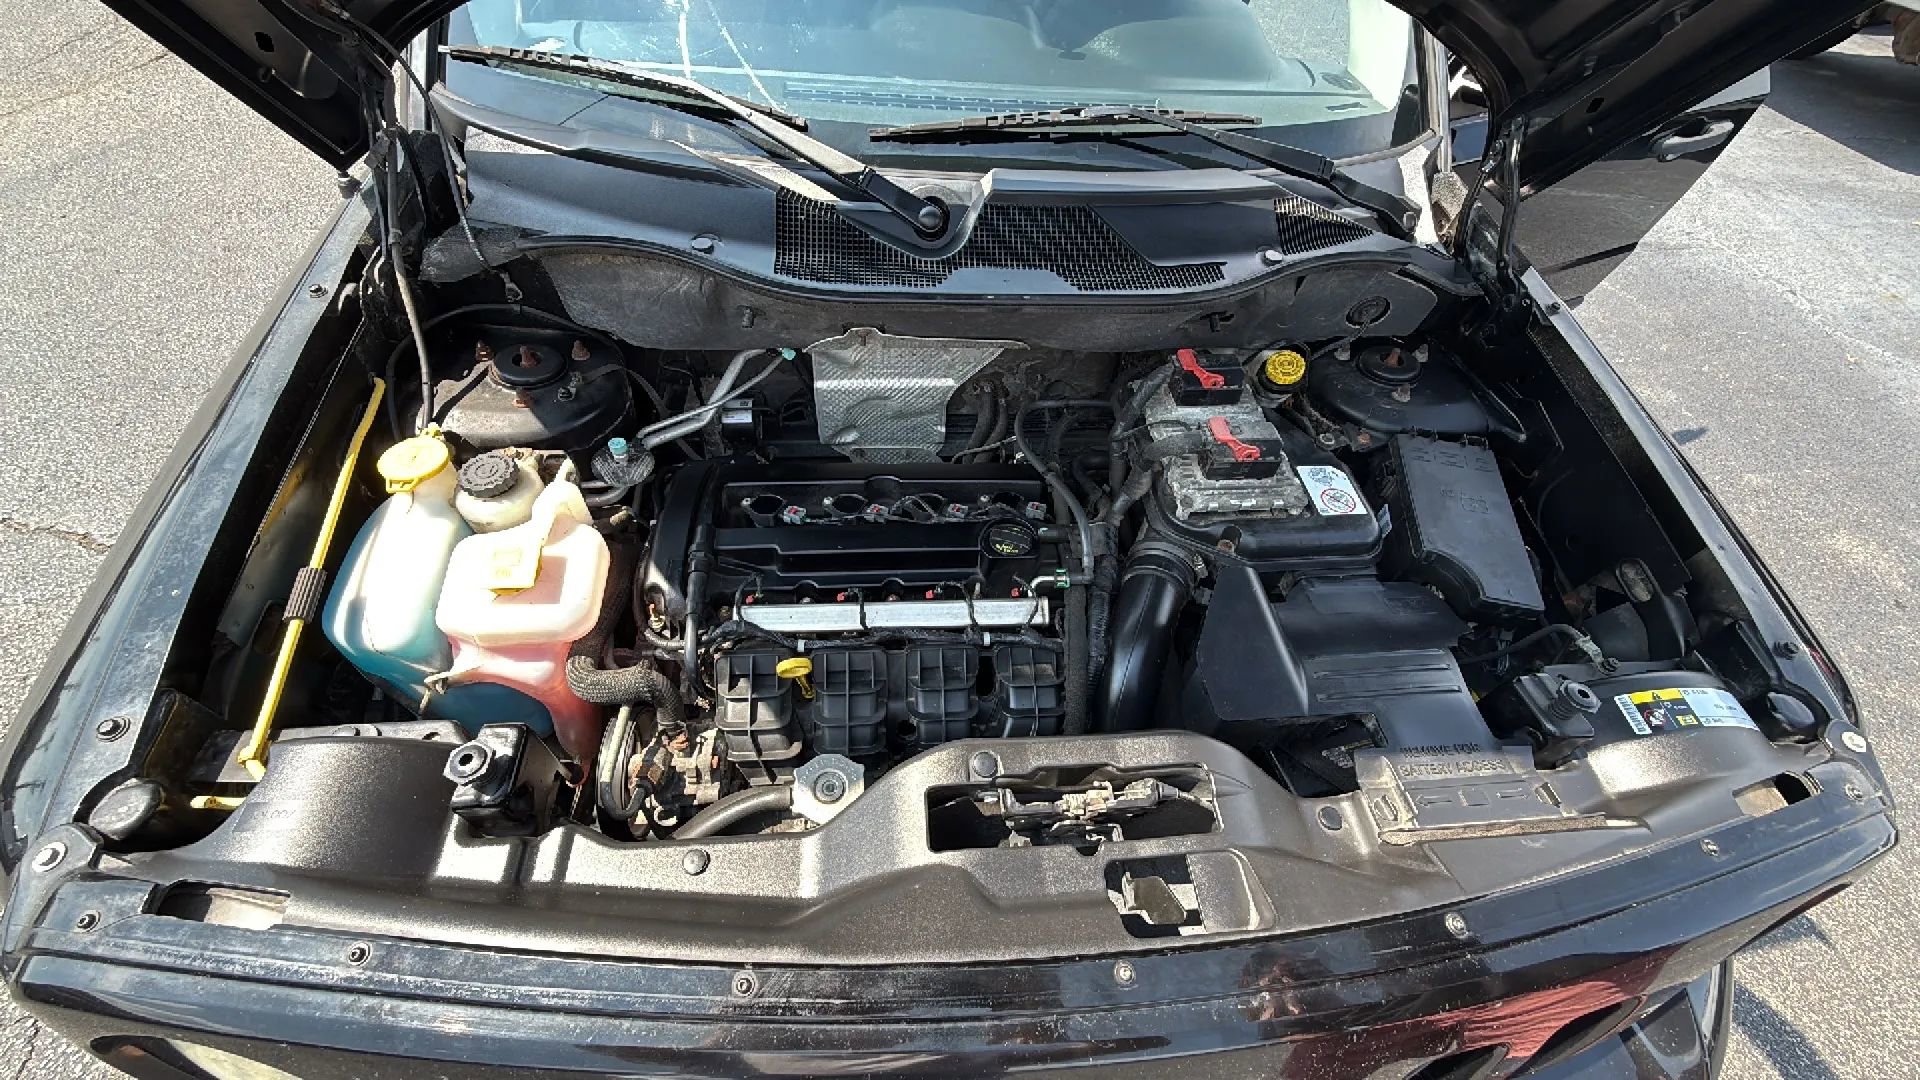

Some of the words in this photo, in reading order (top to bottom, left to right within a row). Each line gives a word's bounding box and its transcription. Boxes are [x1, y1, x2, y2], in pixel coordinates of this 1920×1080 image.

[1400, 744, 1455, 758] REMOVE
[1453, 742, 1481, 755] FOR
[1400, 763, 1453, 777] BATTERY
[1455, 759, 1505, 774] ACCESS
